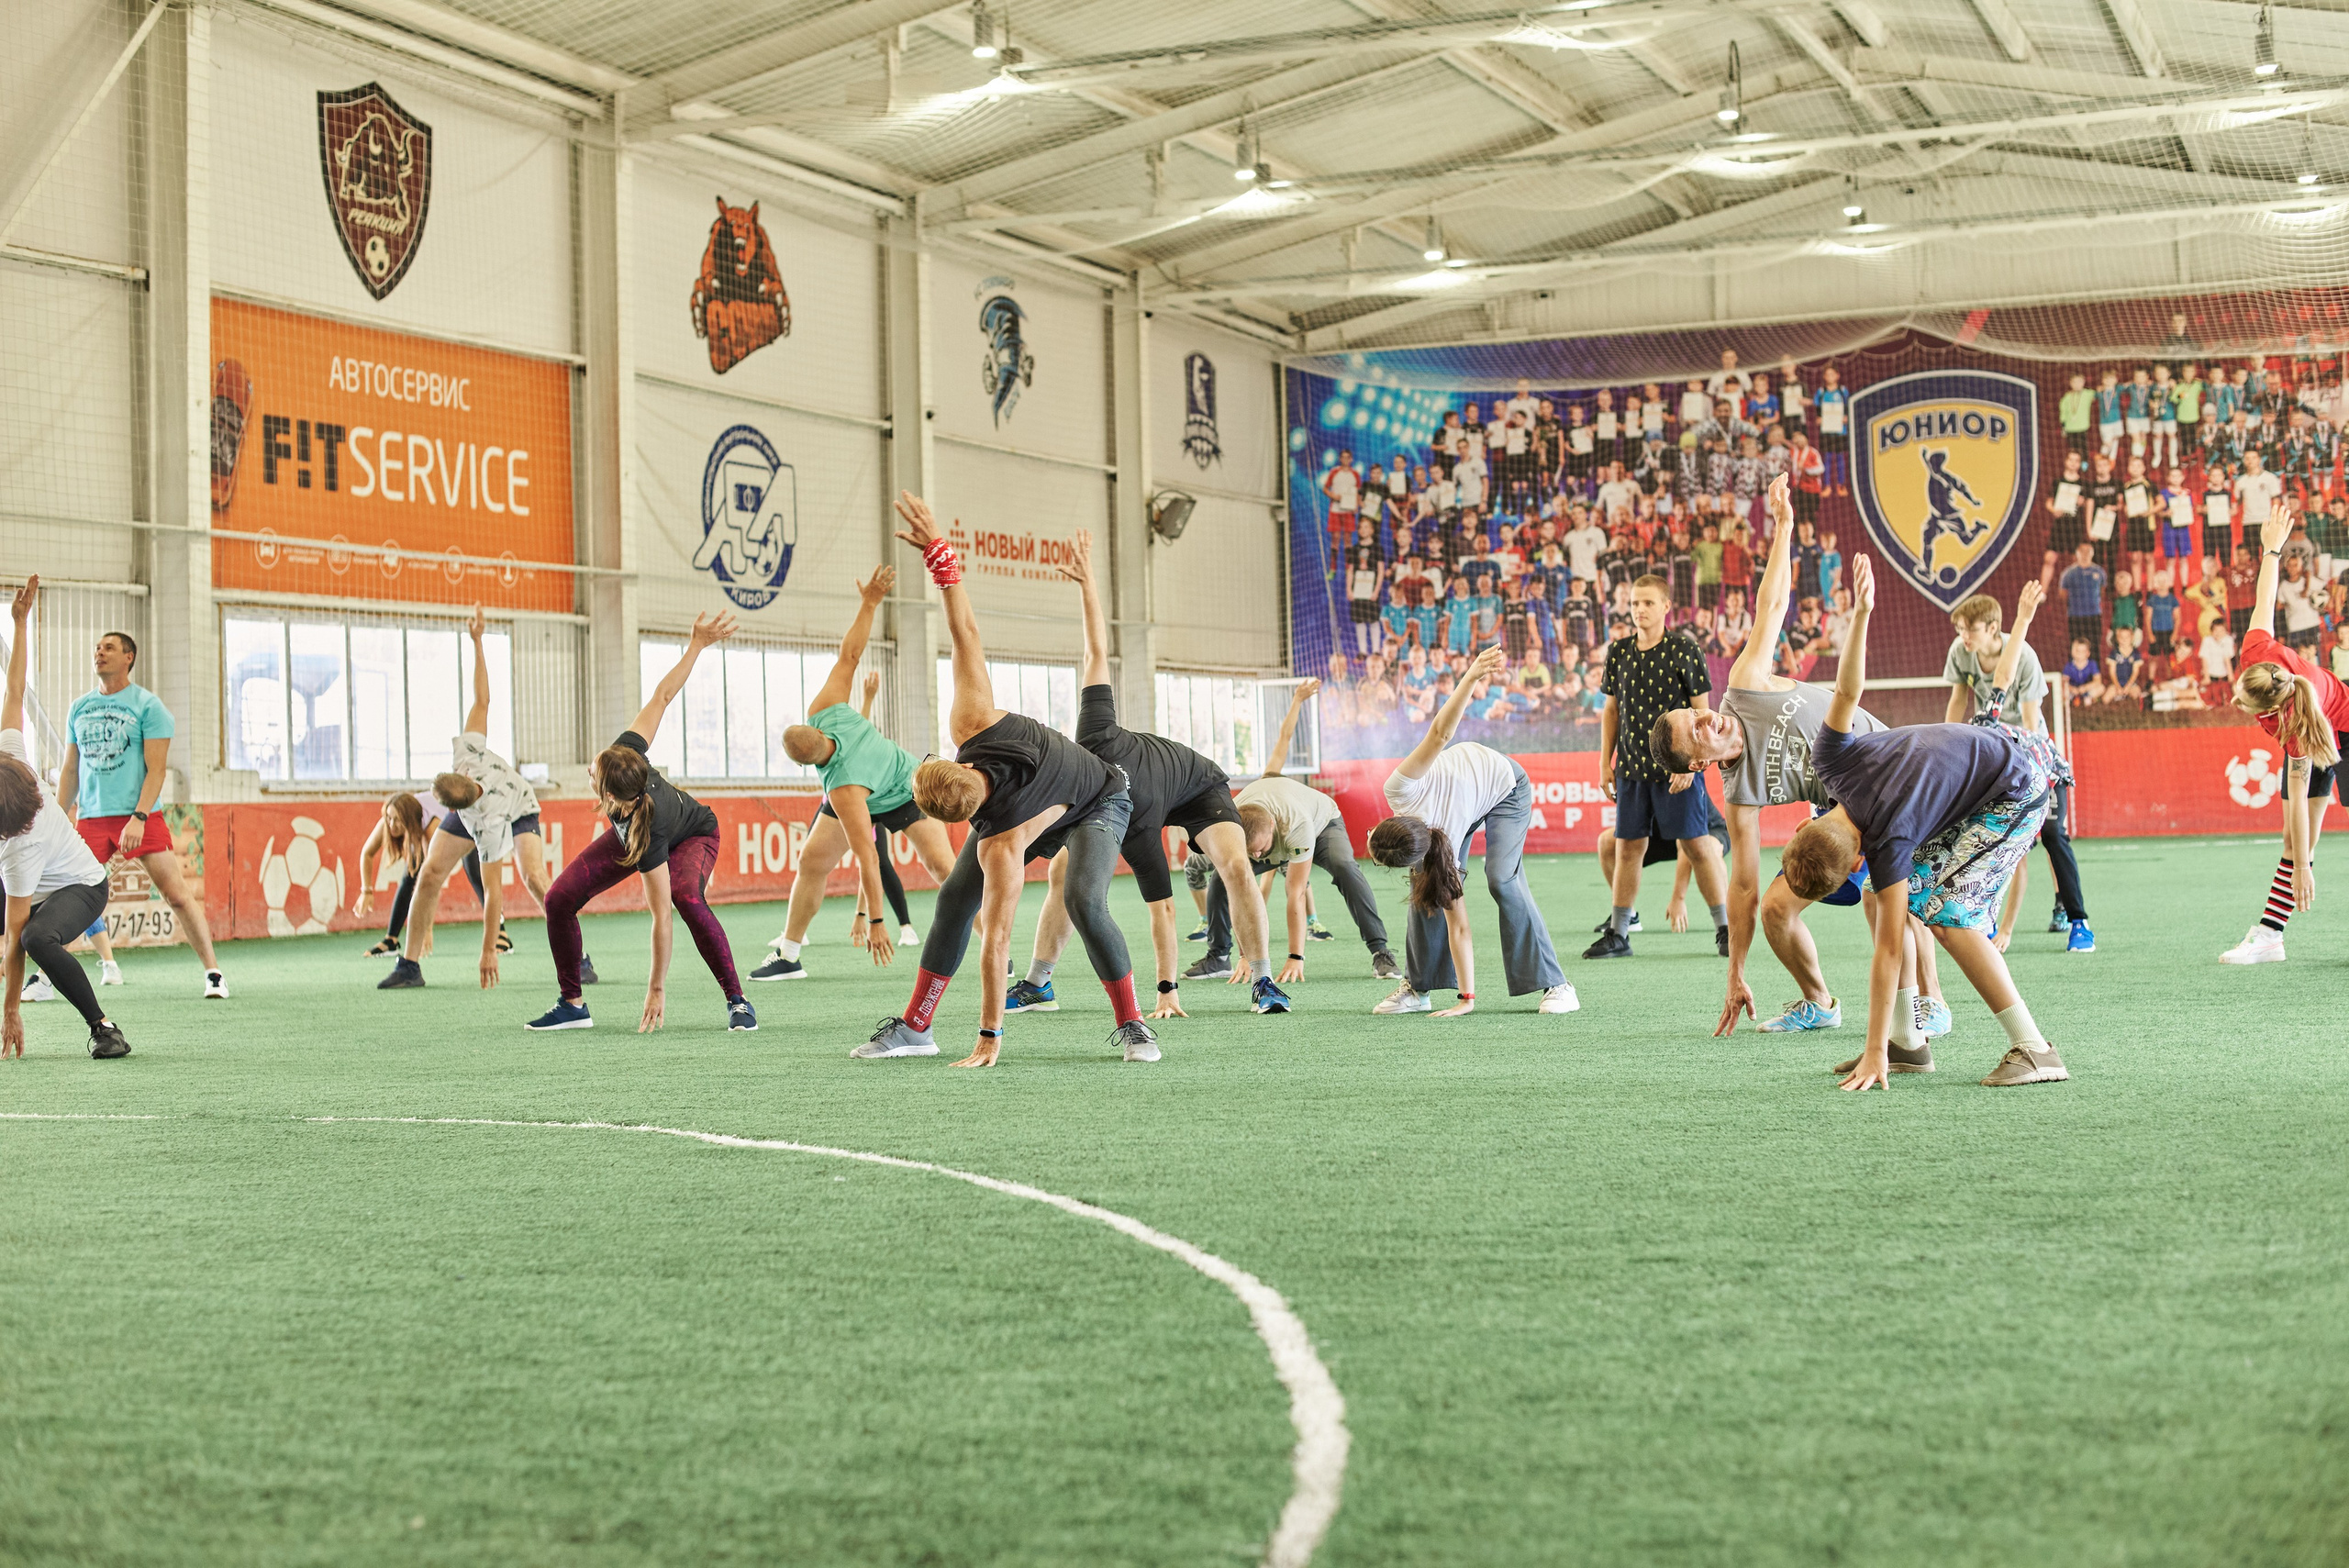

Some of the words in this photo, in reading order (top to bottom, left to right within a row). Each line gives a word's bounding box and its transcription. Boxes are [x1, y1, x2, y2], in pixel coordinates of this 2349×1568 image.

[328, 355, 471, 411] АВТОСЕРВИС
[1879, 410, 2008, 452] ЮНИОР
[348, 426, 530, 517] SERVICE
[974, 529, 1035, 562] НОВЫЙ
[977, 563, 1016, 578] ГРУППА
[1767, 694, 1809, 751] BEACH
[1765, 753, 1787, 805] SOUTH
